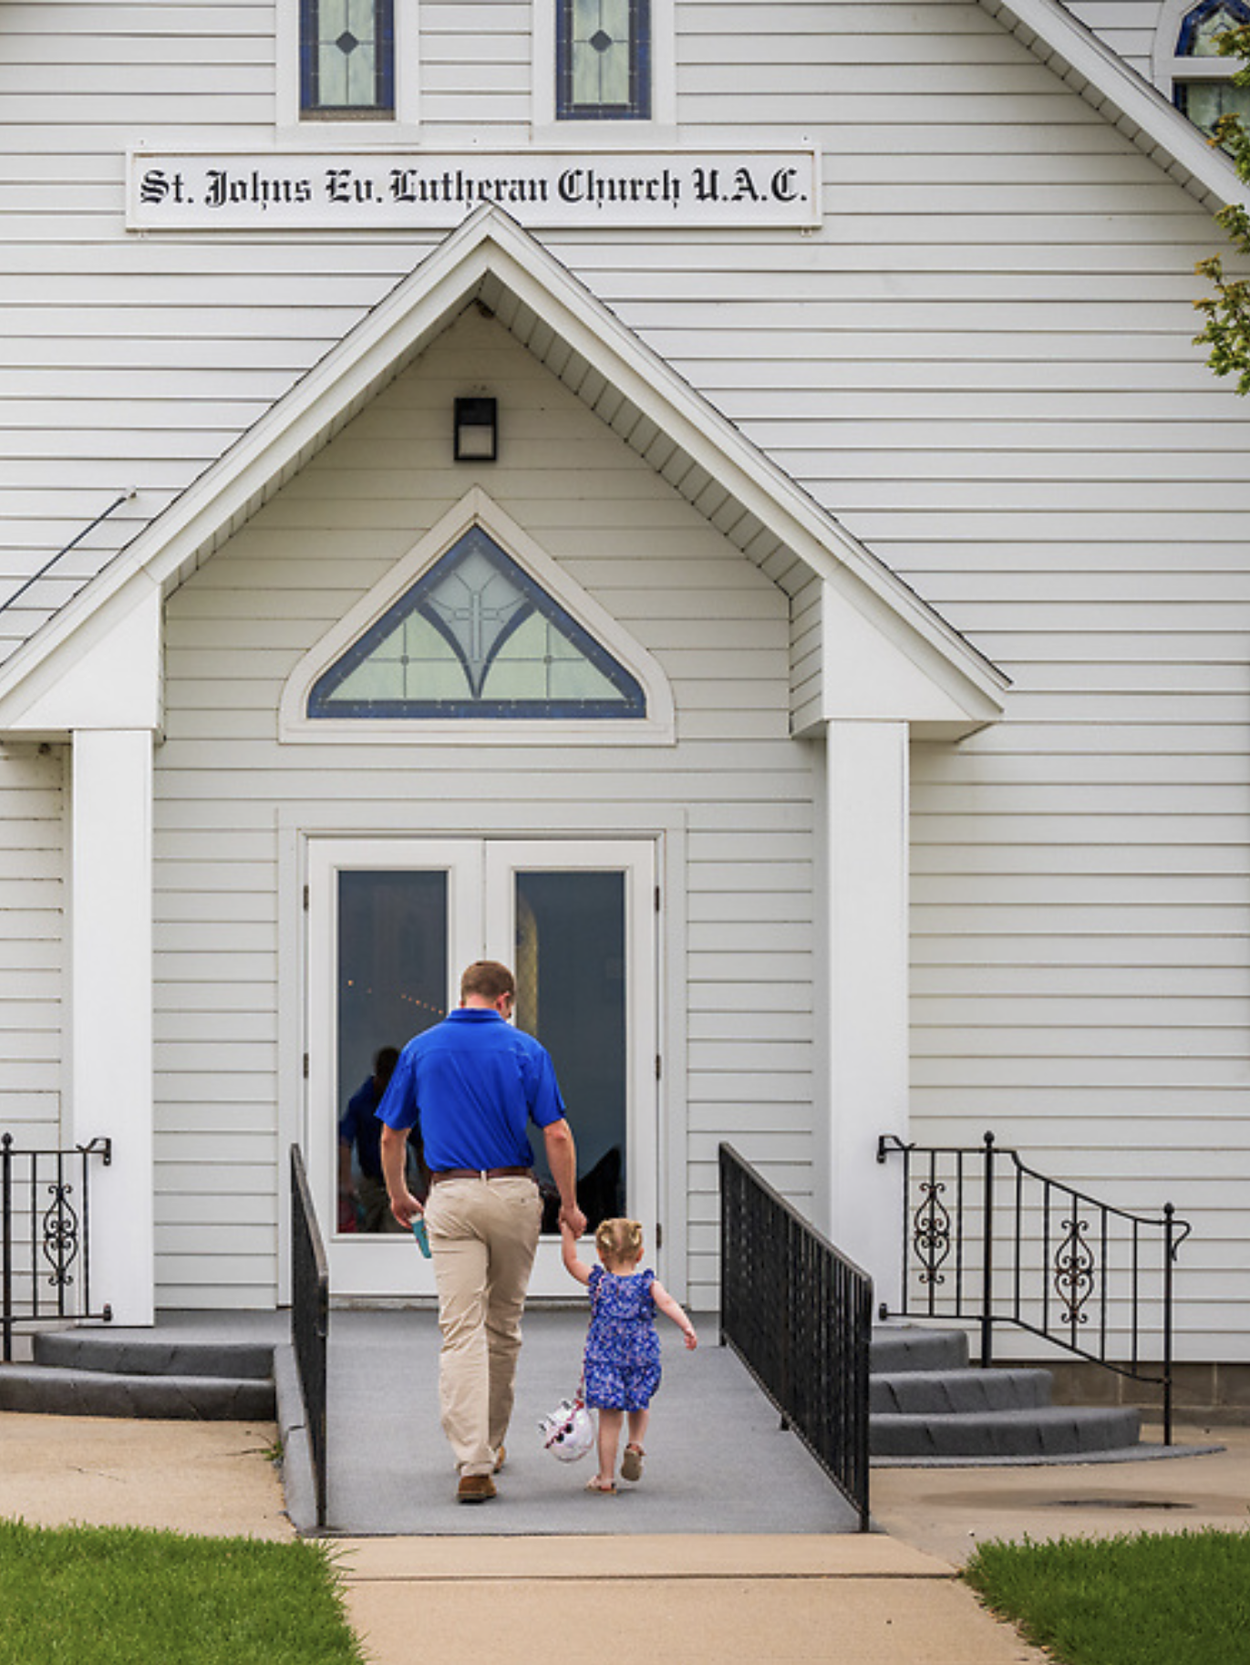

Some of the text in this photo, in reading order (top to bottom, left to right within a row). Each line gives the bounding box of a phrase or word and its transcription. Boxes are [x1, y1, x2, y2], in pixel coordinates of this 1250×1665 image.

[140, 169, 194, 204] St.
[205, 169, 312, 210] Johns
[389, 169, 548, 210] Lutheran
[558, 168, 681, 209] Church
[692, 167, 808, 203] U.A.C.
